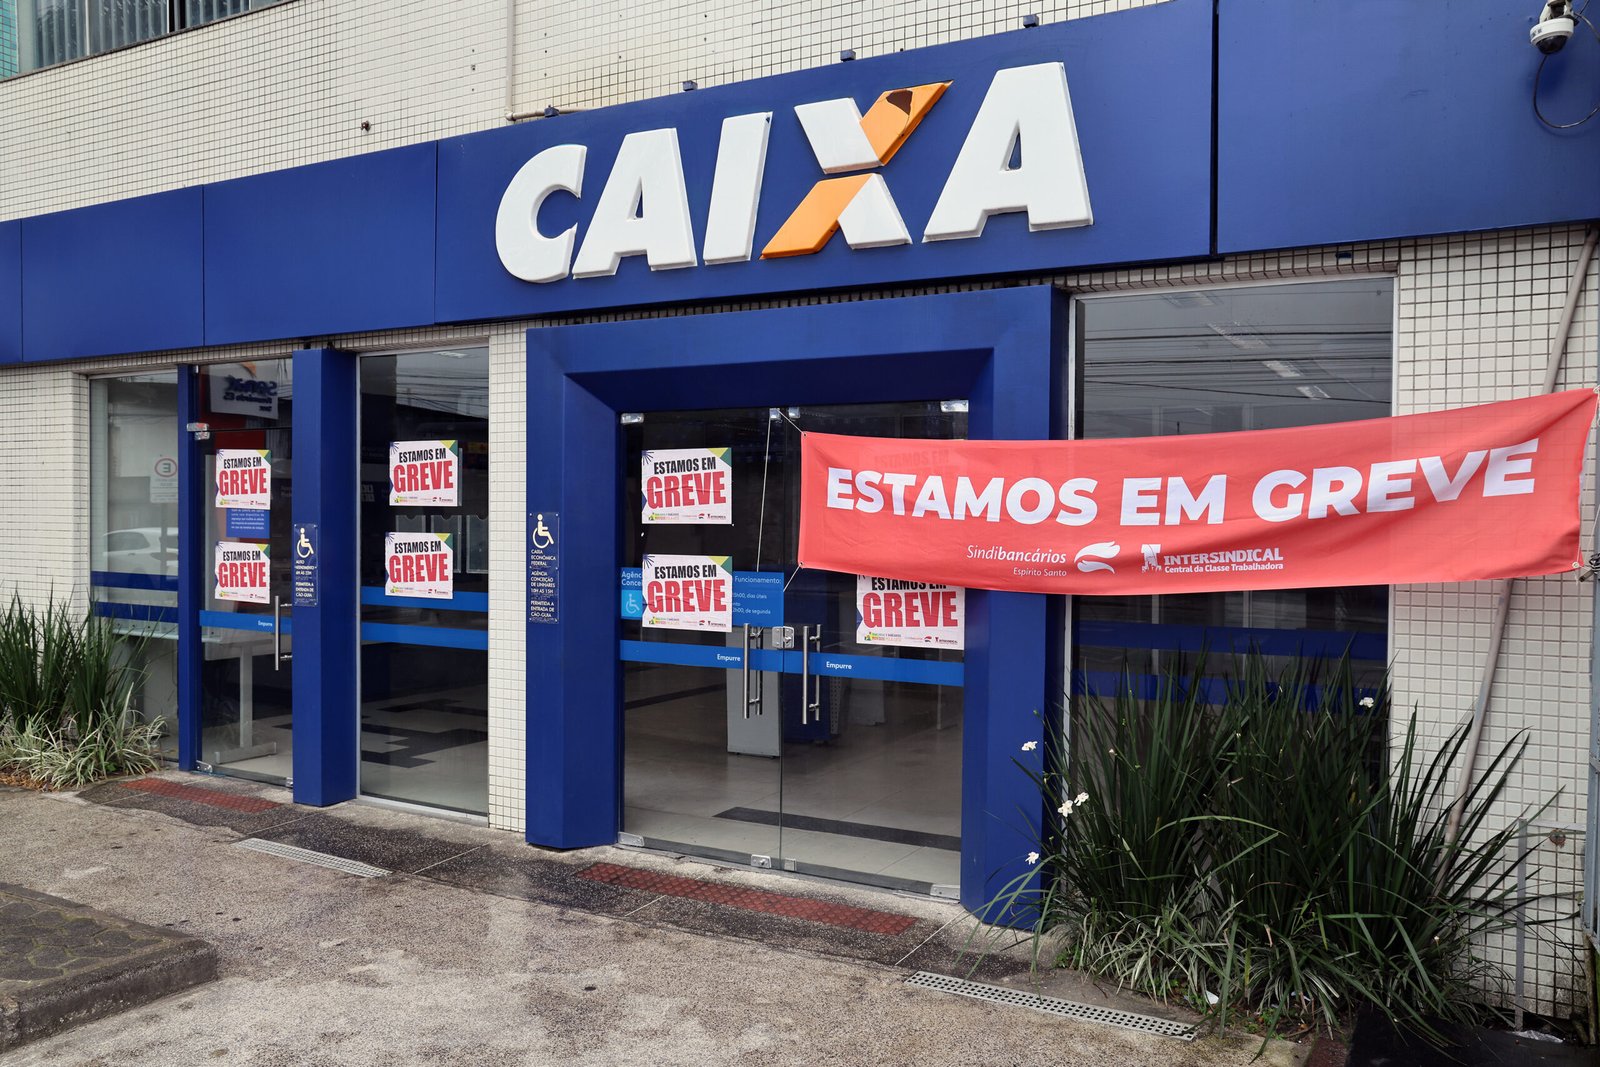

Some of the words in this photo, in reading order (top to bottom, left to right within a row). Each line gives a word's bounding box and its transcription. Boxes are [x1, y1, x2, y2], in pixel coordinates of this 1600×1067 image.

[495, 61, 1094, 284] CAIXA
[223, 457, 252, 469] ESTAMOS
[252, 456, 262, 467] EM
[399, 449, 434, 463] ESTAMOS
[435, 447, 446, 460] EM
[653, 458, 700, 475] ESTAMOS
[701, 456, 717, 471] EM
[219, 468, 267, 496] GREVE
[393, 460, 454, 493] GREVE
[827, 467, 1099, 526] ESTAMOS
[1120, 474, 1228, 526] EM
[1252, 438, 1540, 522] GREVE
[646, 470, 727, 509] GREVE
[222, 550, 251, 561] ESTAMOS
[252, 550, 261, 561] EM
[394, 541, 429, 554] ESTAMOS
[430, 540, 442, 552] EM
[967, 544, 1067, 564] Sindibancários
[1164, 547, 1283, 565] INTERSINDICAL
[218, 562, 267, 588] GREVE
[389, 553, 449, 583] GREVE
[654, 565, 700, 579] ESTAMOS
[702, 564, 717, 578] EM
[1013, 567, 1041, 578] Espírito
[1043, 568, 1067, 577] Santo
[1165, 564, 1192, 574] Central
[1194, 564, 1203, 572] da
[1204, 563, 1230, 572] Classe
[1231, 562, 1284, 572] Trabalhadora
[647, 578, 727, 613] GREVE
[863, 591, 958, 628] GREVE
[717, 653, 741, 662] Empurre
[826, 660, 852, 671] Empurre
